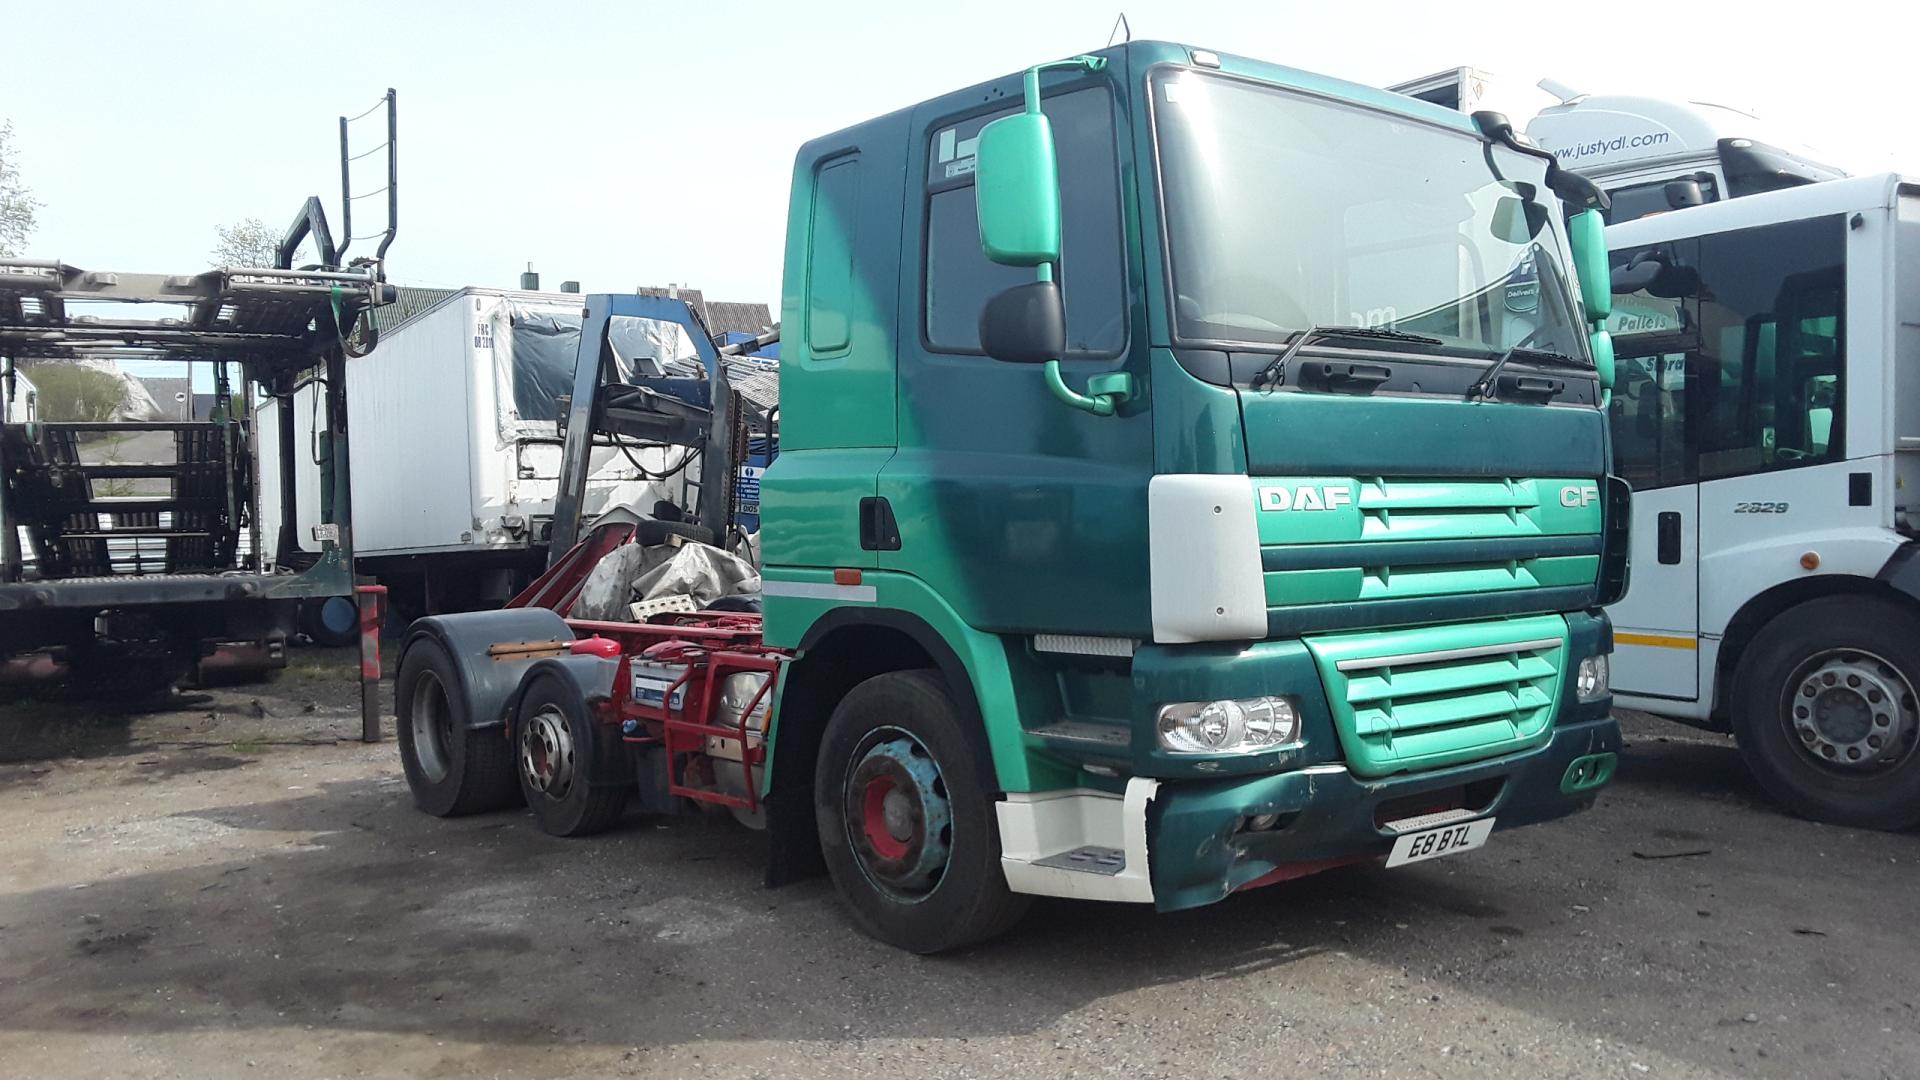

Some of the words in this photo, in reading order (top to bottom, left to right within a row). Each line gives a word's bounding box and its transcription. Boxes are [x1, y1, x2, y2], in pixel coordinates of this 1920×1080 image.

[1618, 314, 1667, 331] Pallets
[1258, 486, 1351, 512] DAF
[1560, 486, 1597, 508] CF
[1408, 833, 1438, 858] E8
[1436, 825, 1471, 852] BTL
